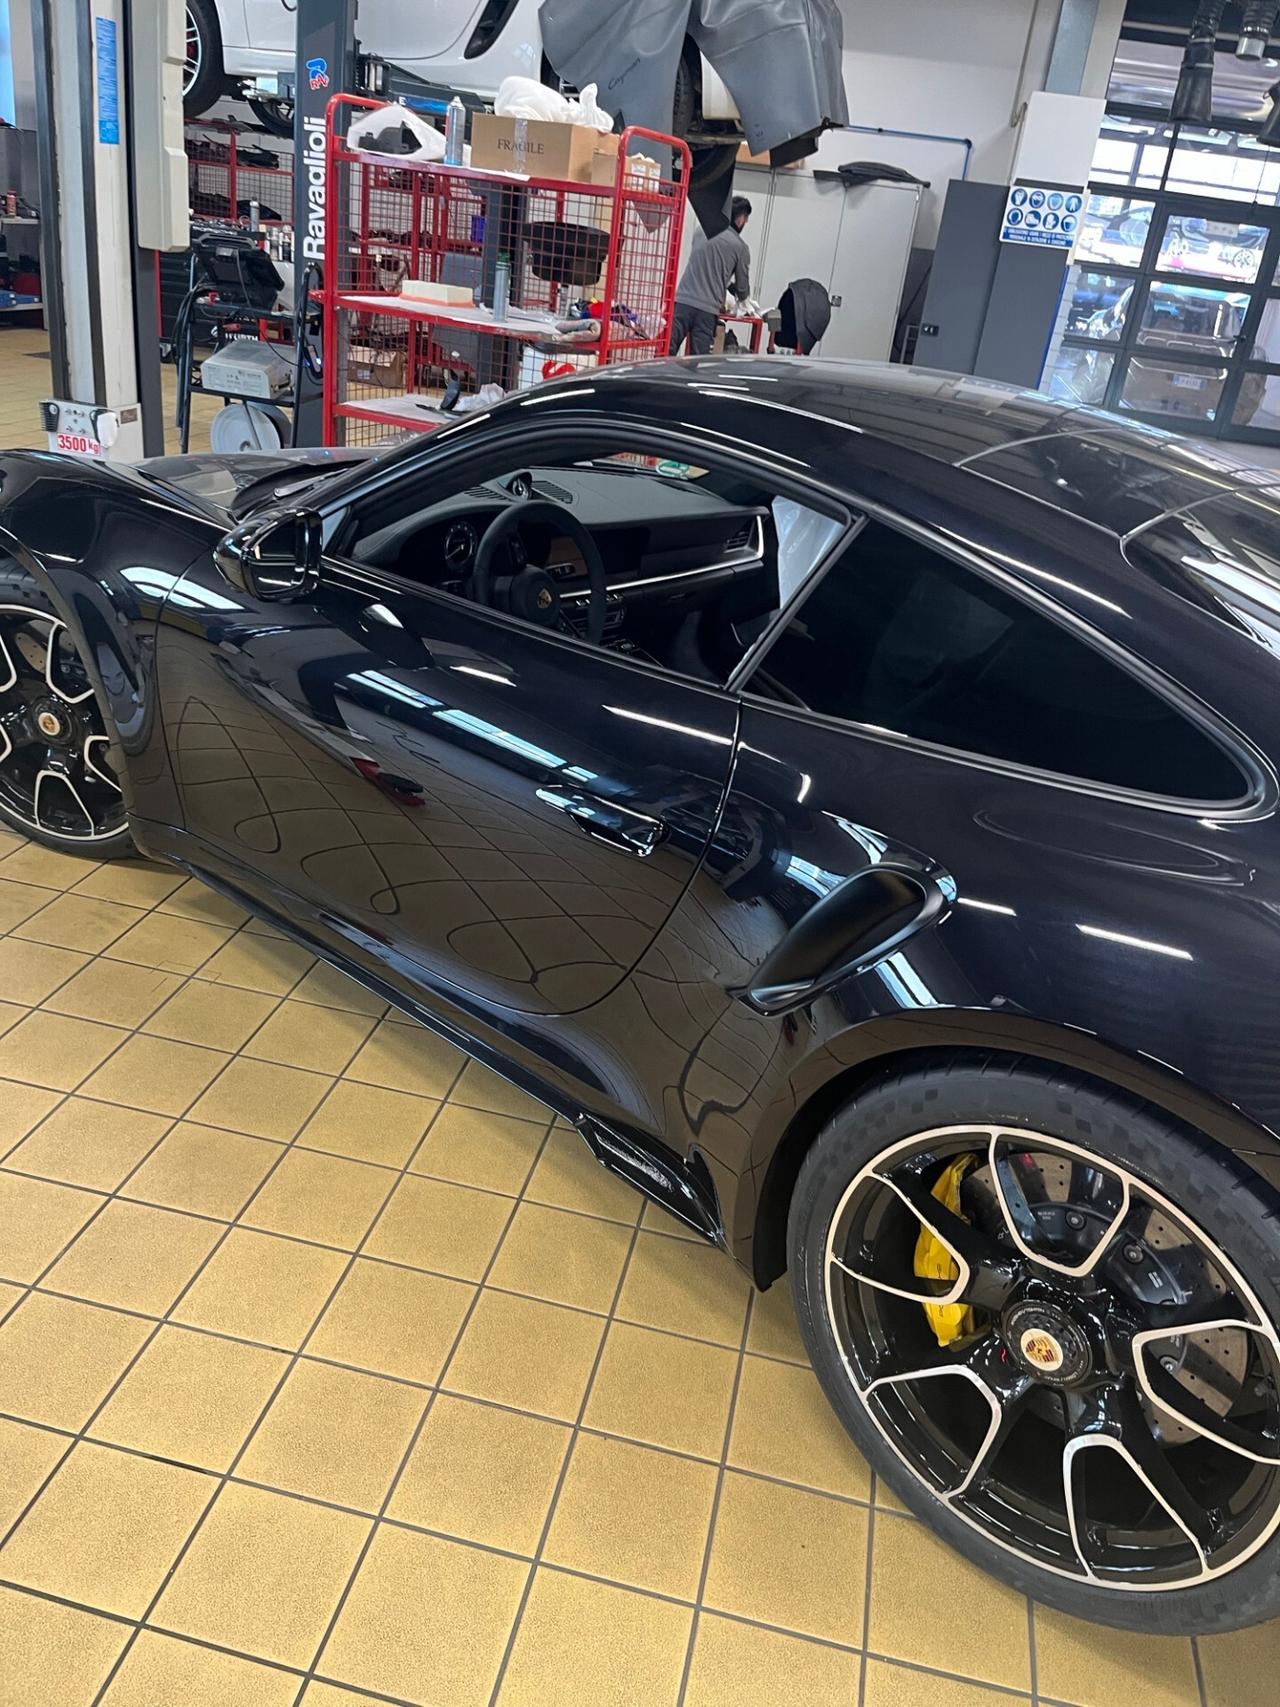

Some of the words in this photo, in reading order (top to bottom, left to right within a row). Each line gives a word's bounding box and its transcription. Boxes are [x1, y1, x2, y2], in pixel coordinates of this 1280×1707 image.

[497, 137, 545, 155] FRAGILE
[58, 434, 87, 452] 3500
[88, 440, 101, 455] kg
